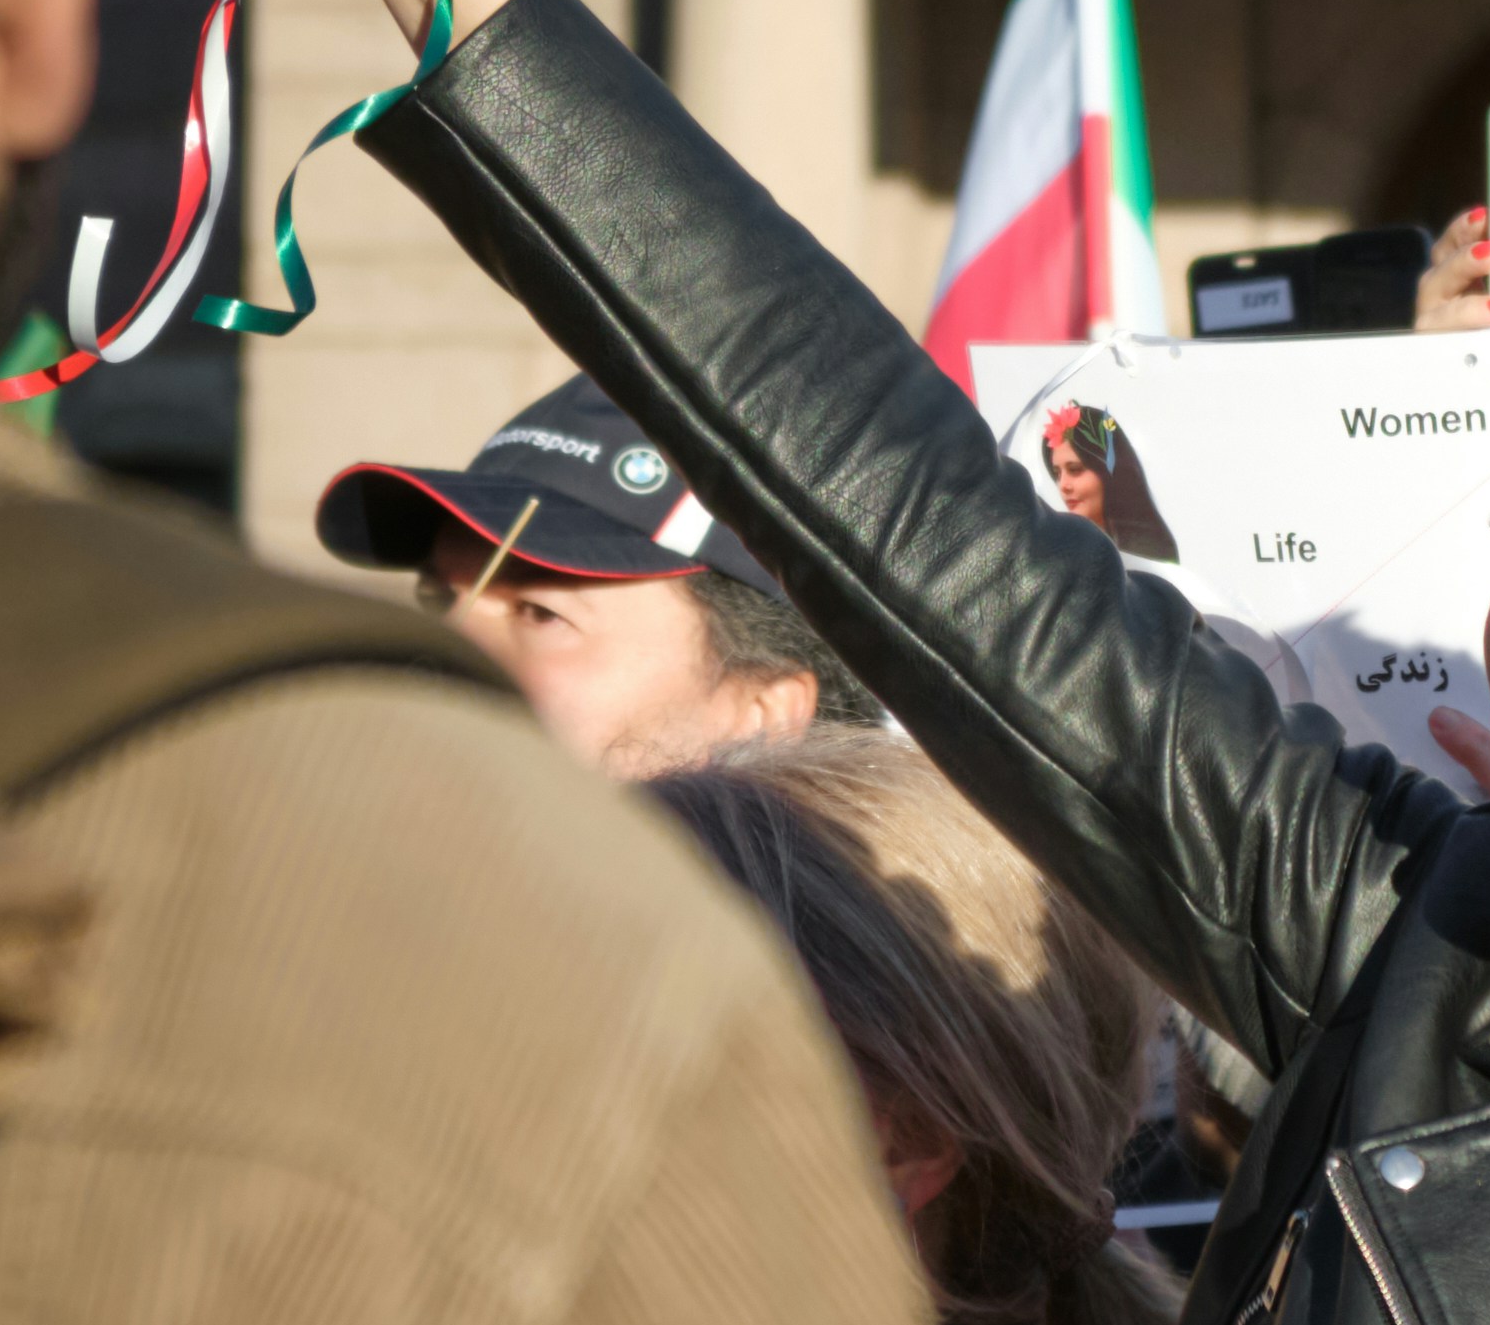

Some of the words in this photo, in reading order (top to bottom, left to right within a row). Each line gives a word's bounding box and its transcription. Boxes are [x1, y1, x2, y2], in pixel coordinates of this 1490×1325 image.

[1340, 407, 1487, 439] Women
[1253, 532, 1318, 563] Life
[1356, 652, 1449, 693] زندگی
